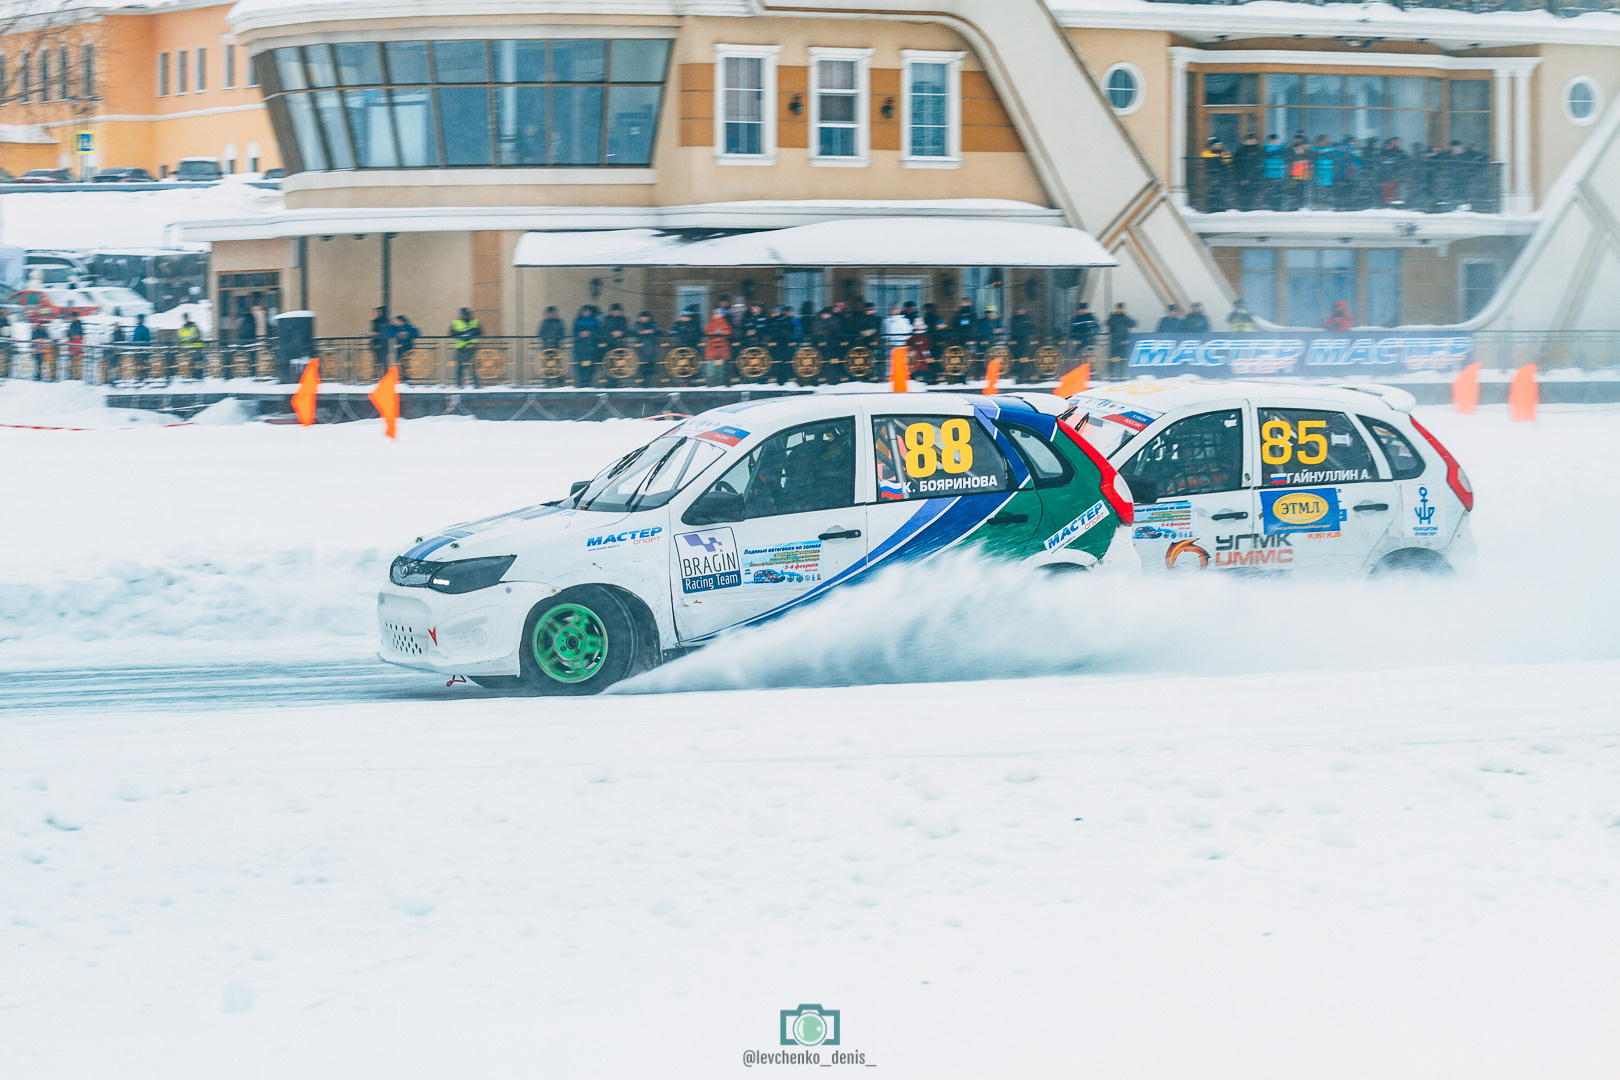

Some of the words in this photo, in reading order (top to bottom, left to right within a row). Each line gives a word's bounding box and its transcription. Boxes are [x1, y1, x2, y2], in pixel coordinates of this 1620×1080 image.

[1128, 339, 1306, 367] МАСТЕР
[904, 418, 973, 478] 88
[1261, 420, 1328, 465] 85
[903, 481, 915, 493] К.
[920, 475, 998, 492] БОЯРИНОВА
[1286, 469, 1358, 484] ГАЙНУЛЛИН
[1360, 468, 1372, 480] А.
[1281, 501, 1320, 515] ЭТМЛ
[1047, 502, 1103, 549] МАСТЕР
[1084, 512, 1104, 531] СПОРТ
[586, 526, 663, 547] МАСТЕР
[633, 536, 661, 545] СПОРТ
[1215, 533, 1293, 551] УГМК
[682, 552, 737, 577] BRAGIN
[1215, 549, 1294, 566] UMMC
[685, 577, 715, 590] Racing
[716, 573, 739, 586] Team
